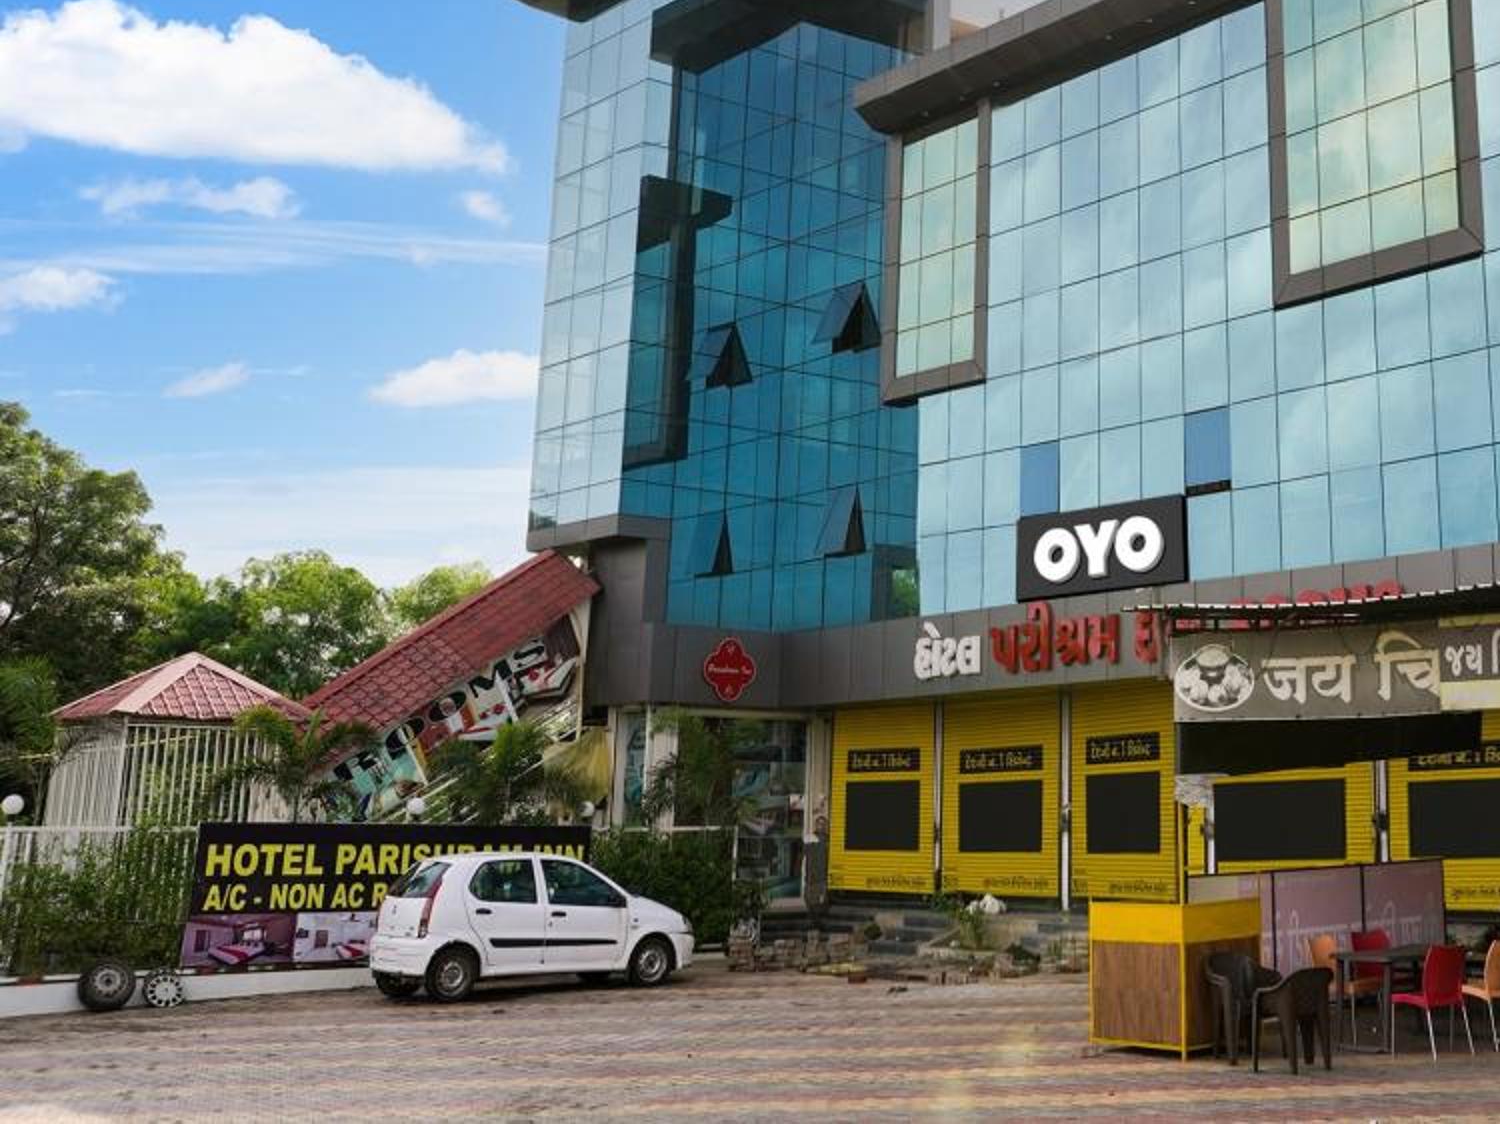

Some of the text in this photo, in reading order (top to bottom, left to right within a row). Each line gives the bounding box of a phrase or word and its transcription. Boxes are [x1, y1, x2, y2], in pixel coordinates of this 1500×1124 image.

[1034, 516, 1164, 583] OYO
[913, 621, 982, 679] હોટલ
[1443, 643, 1483, 676] જય
[1261, 653, 1357, 704] जय
[205, 843, 324, 877] HOTEL
[202, 884, 247, 912] A/C
[269, 883, 325, 910] NON
[330, 882, 365, 909] AC
